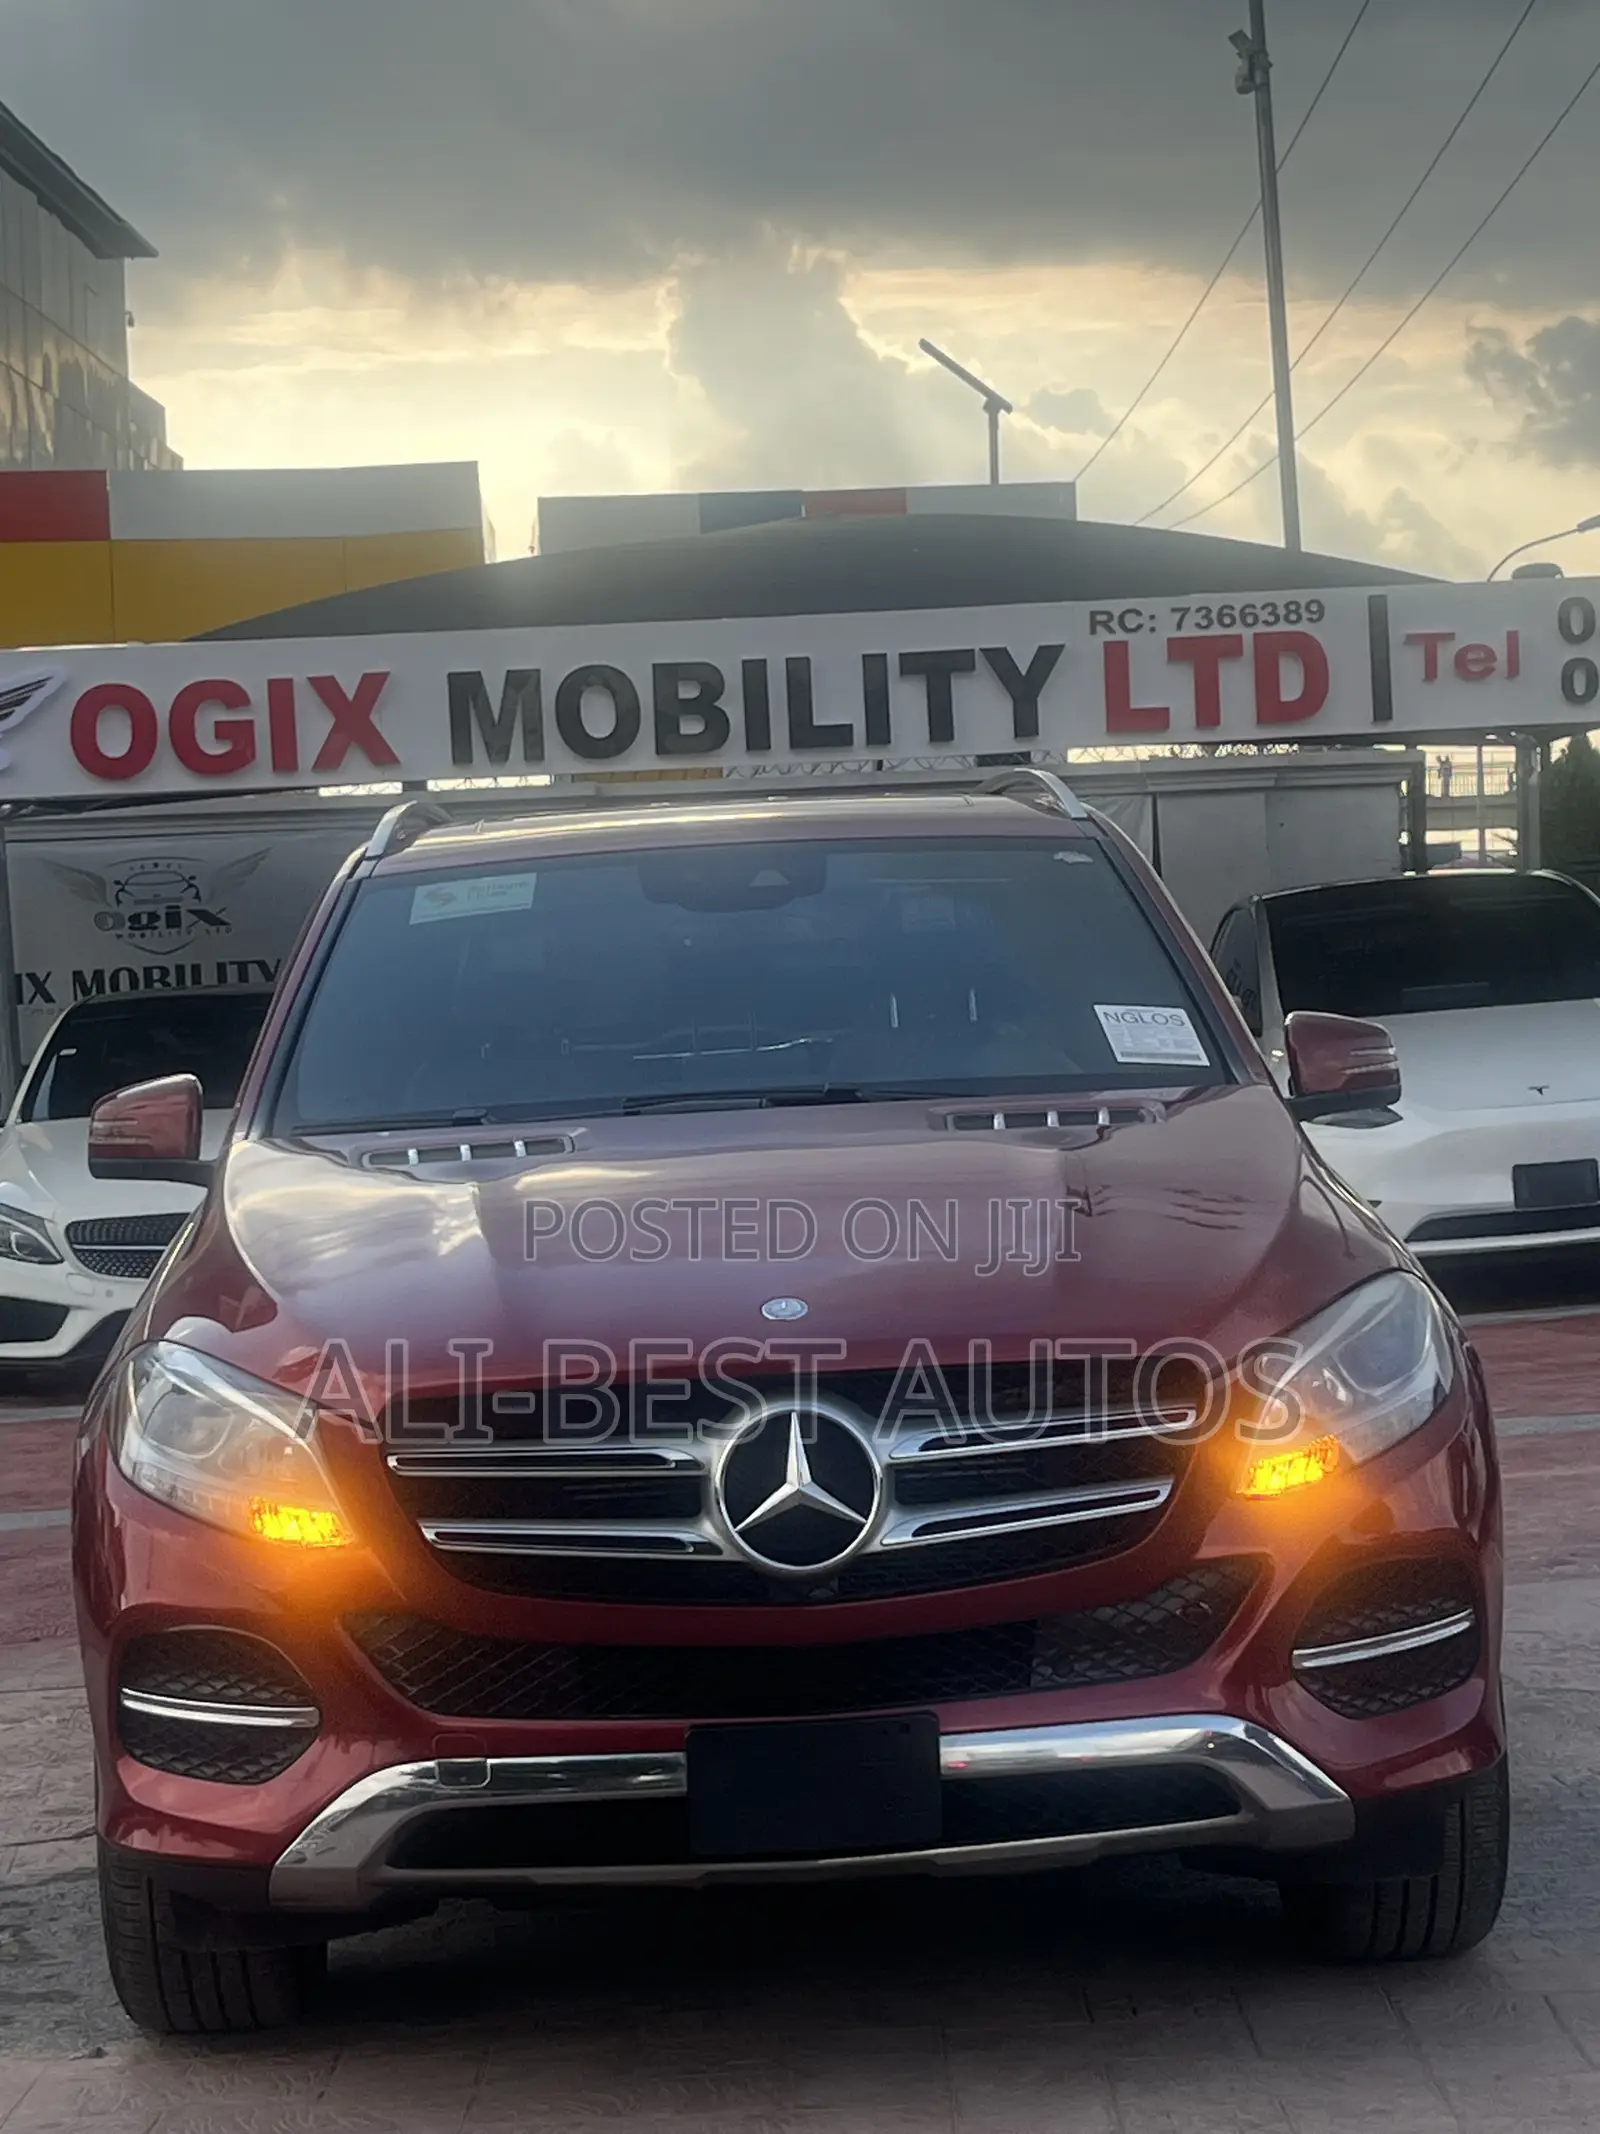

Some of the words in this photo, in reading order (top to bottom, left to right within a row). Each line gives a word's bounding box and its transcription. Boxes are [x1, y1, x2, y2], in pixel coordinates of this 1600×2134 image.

[1089, 608, 1156, 636] RC:
[1171, 599, 1325, 631] 7366389
[1404, 629, 1521, 683] Tel
[70, 671, 400, 781] OGIX
[446, 644, 1066, 766] MOBILITY
[1102, 630, 1330, 733] LTD
[1103, 1010, 1186, 1027] NGLOS
